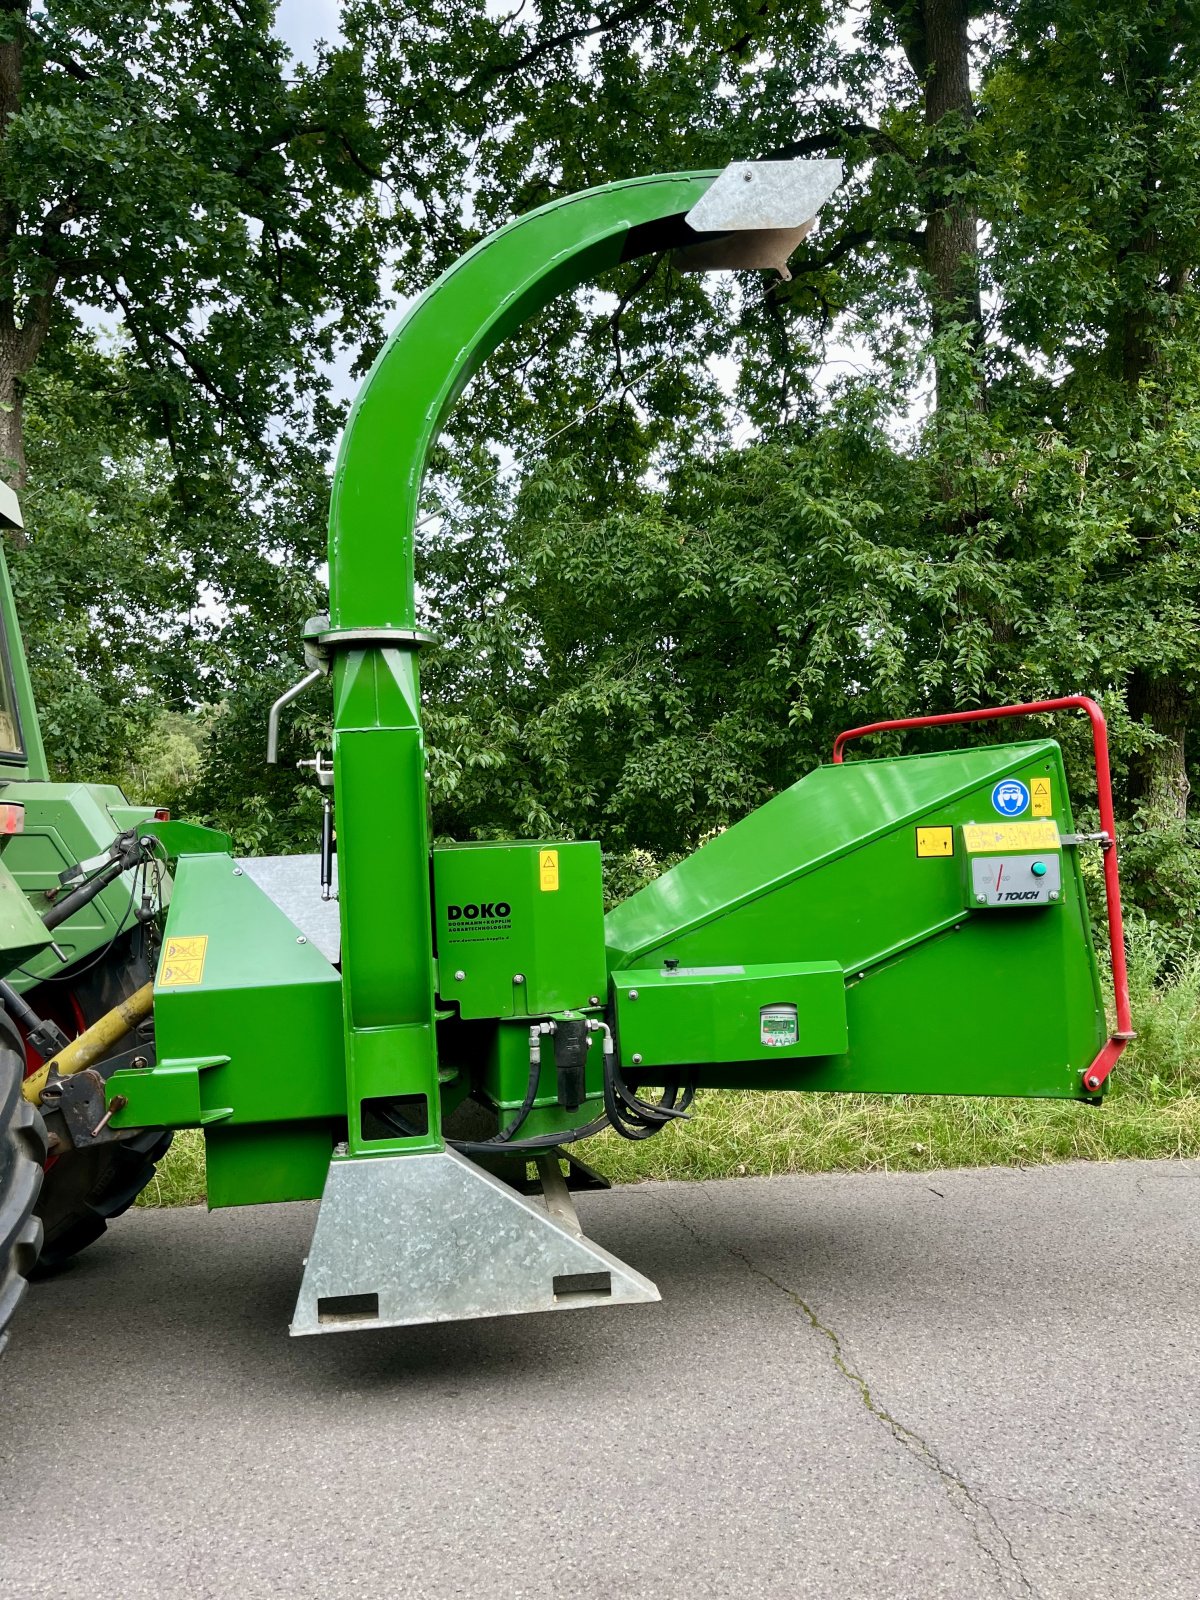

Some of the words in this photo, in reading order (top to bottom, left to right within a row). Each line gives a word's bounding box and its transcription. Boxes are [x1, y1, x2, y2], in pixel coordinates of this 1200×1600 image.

[997, 893, 1003, 901] 1
[1005, 891, 1040, 901] TOUCH
[447, 902, 511, 920] DOKO
